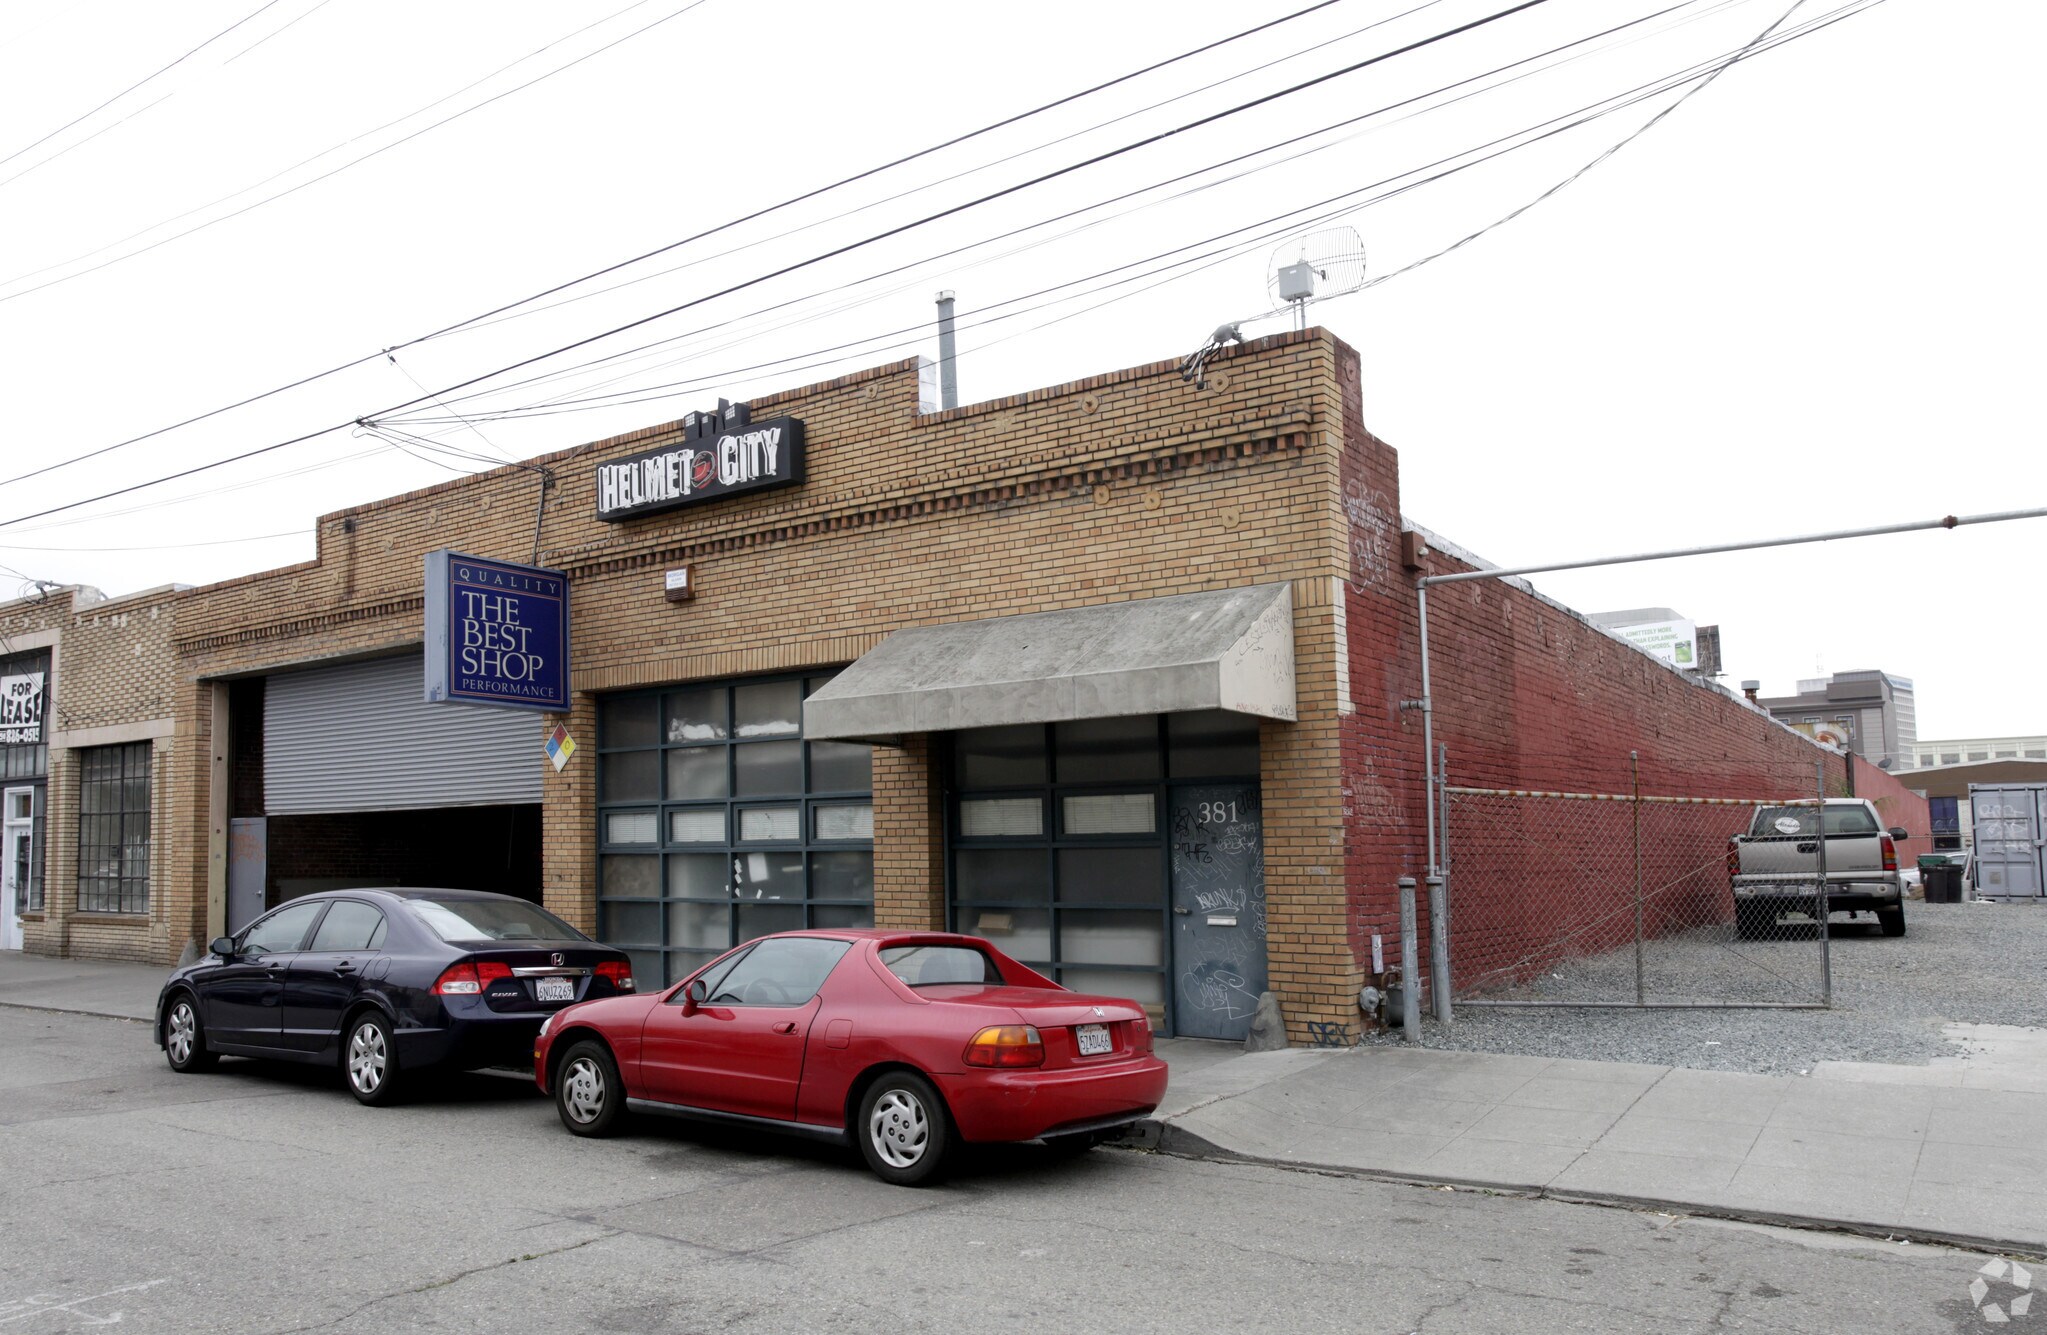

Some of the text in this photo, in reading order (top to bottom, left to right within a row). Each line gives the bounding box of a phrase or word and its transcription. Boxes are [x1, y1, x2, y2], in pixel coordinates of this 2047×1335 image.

[598, 427, 781, 513] HELMET CITY
[460, 567, 556, 594] QUALITY
[461, 590, 520, 626] THE
[462, 618, 532, 653] BEST
[1647, 633, 1678, 642] EXPLAINING
[461, 646, 544, 682] SHOP
[11, 682, 32, 697] FOR
[462, 678, 554, 697] PERFORMANCE
[0, 691, 41, 725] LEASE
[1199, 801, 1239, 824] 381
[539, 985, 572, 999] 6NUZ269
